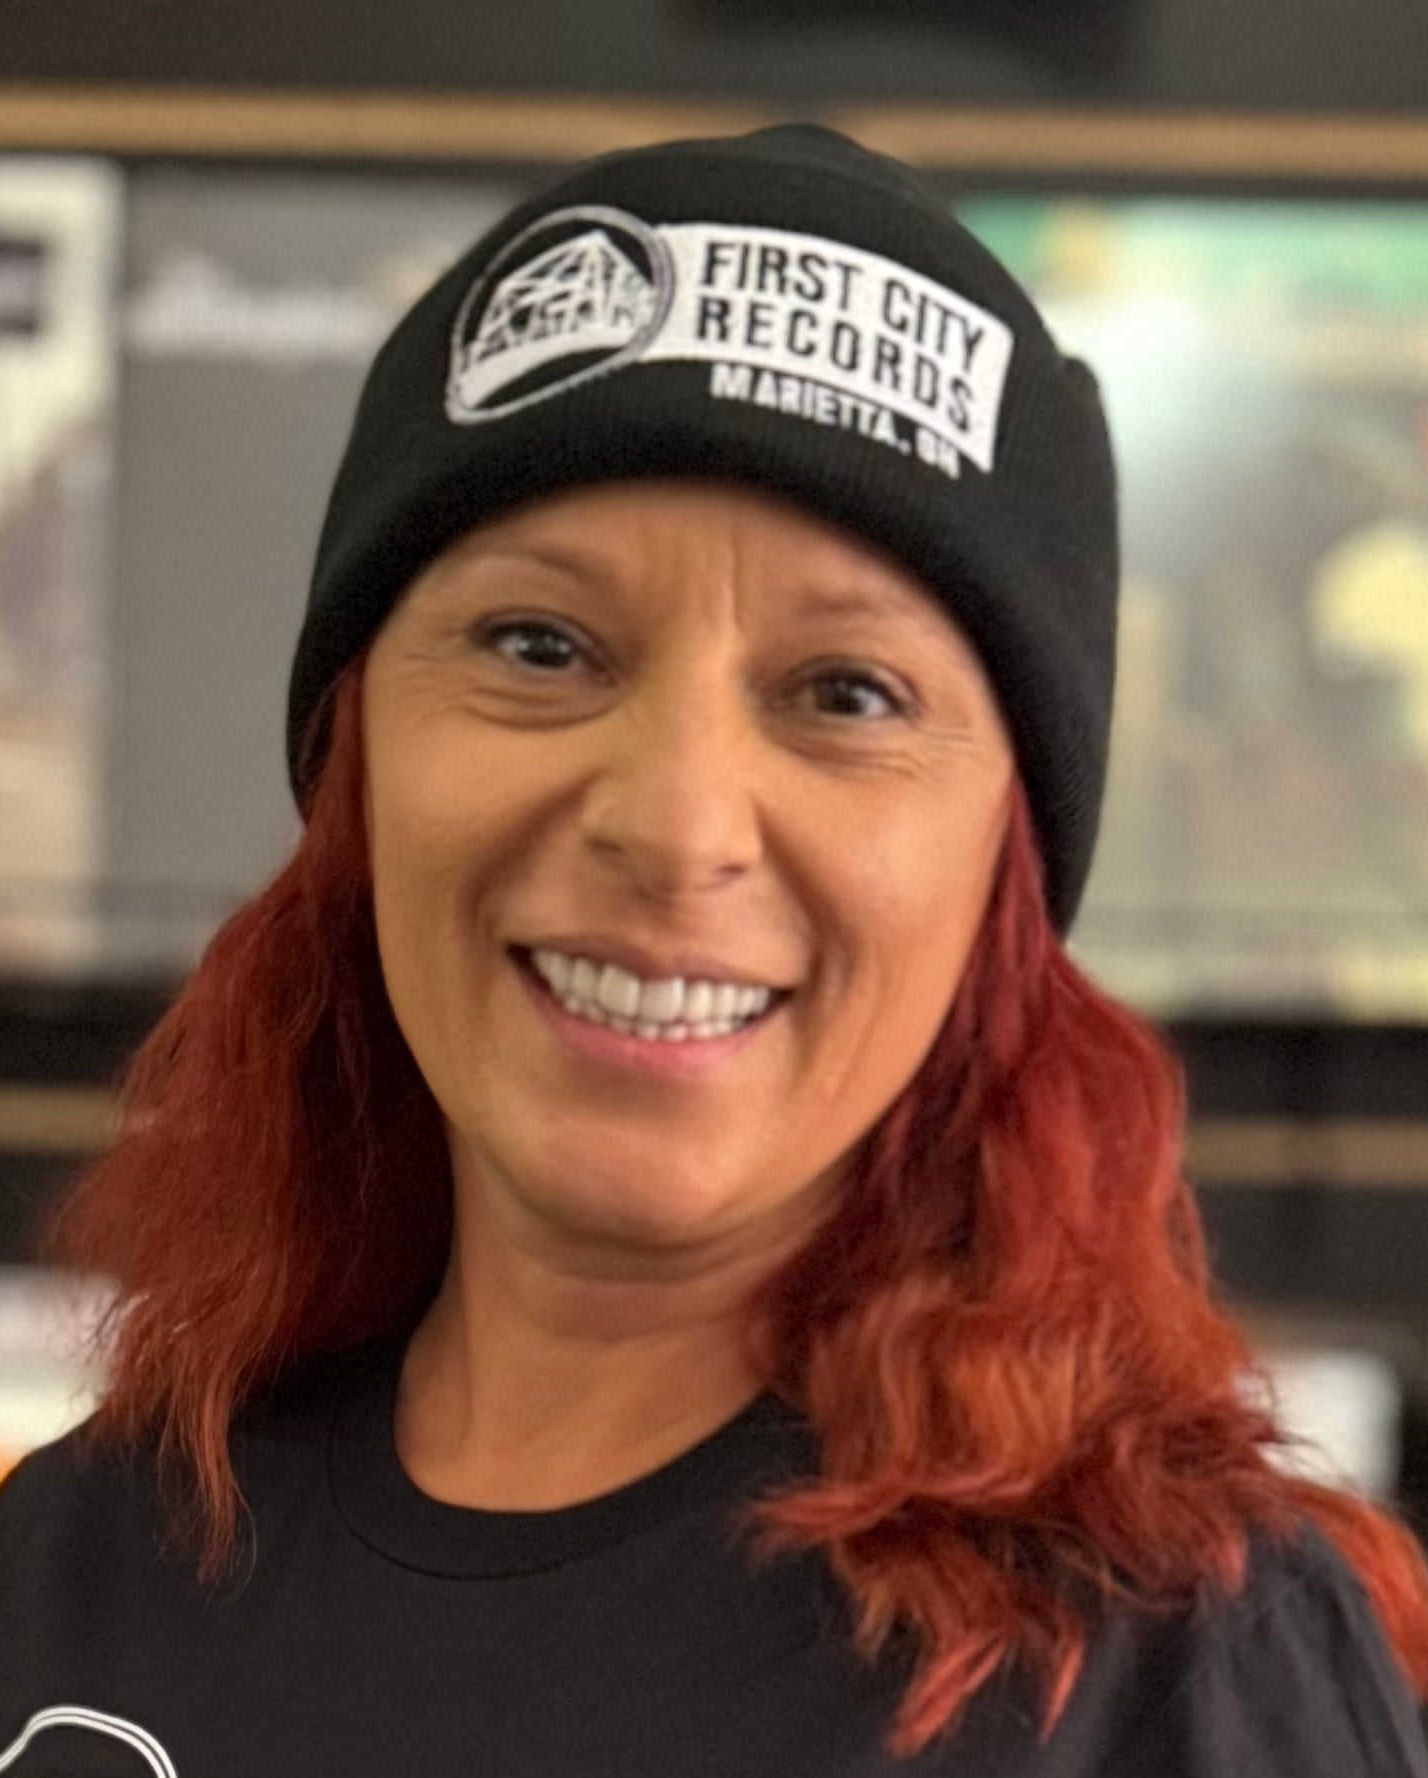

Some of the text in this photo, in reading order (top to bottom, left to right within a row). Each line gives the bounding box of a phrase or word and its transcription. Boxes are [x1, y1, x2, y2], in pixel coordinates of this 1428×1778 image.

[694, 293, 974, 435] RECORDS
[700, 239, 985, 372] FIRST CITY
[709, 363, 961, 481] MARIETTA, OH
